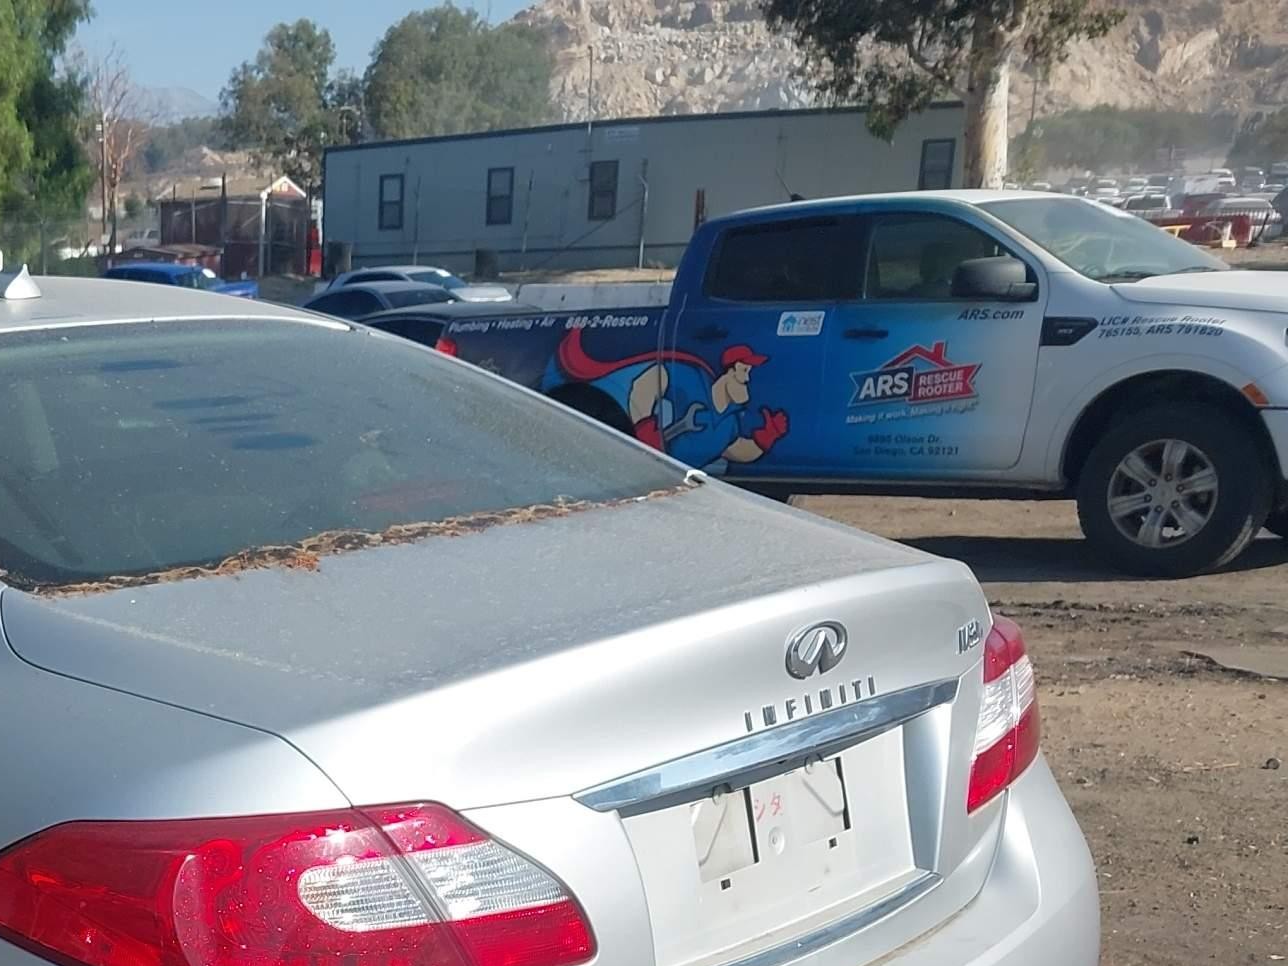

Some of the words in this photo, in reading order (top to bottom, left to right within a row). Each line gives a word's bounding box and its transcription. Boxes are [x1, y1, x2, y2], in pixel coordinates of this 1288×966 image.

[958, 308, 1025, 321] ARS.com
[1099, 316, 1130, 327] LIC#
[1132, 316, 1178, 325] Rescue
[1179, 315, 1228, 325] Rooter
[449, 320, 490, 333] Plumbing
[497, 318, 533, 330] Heating
[540, 315, 556, 327] Air
[565, 315, 649, 329] 888-2-Rescue
[1145, 324, 1173, 335] ARS
[859, 372, 910, 399] ARS
[918, 369, 965, 386] RESCUE
[917, 381, 964, 398] ROOTER
[909, 445, 925, 456] CA
[744, 676, 876, 733] INFINITI
